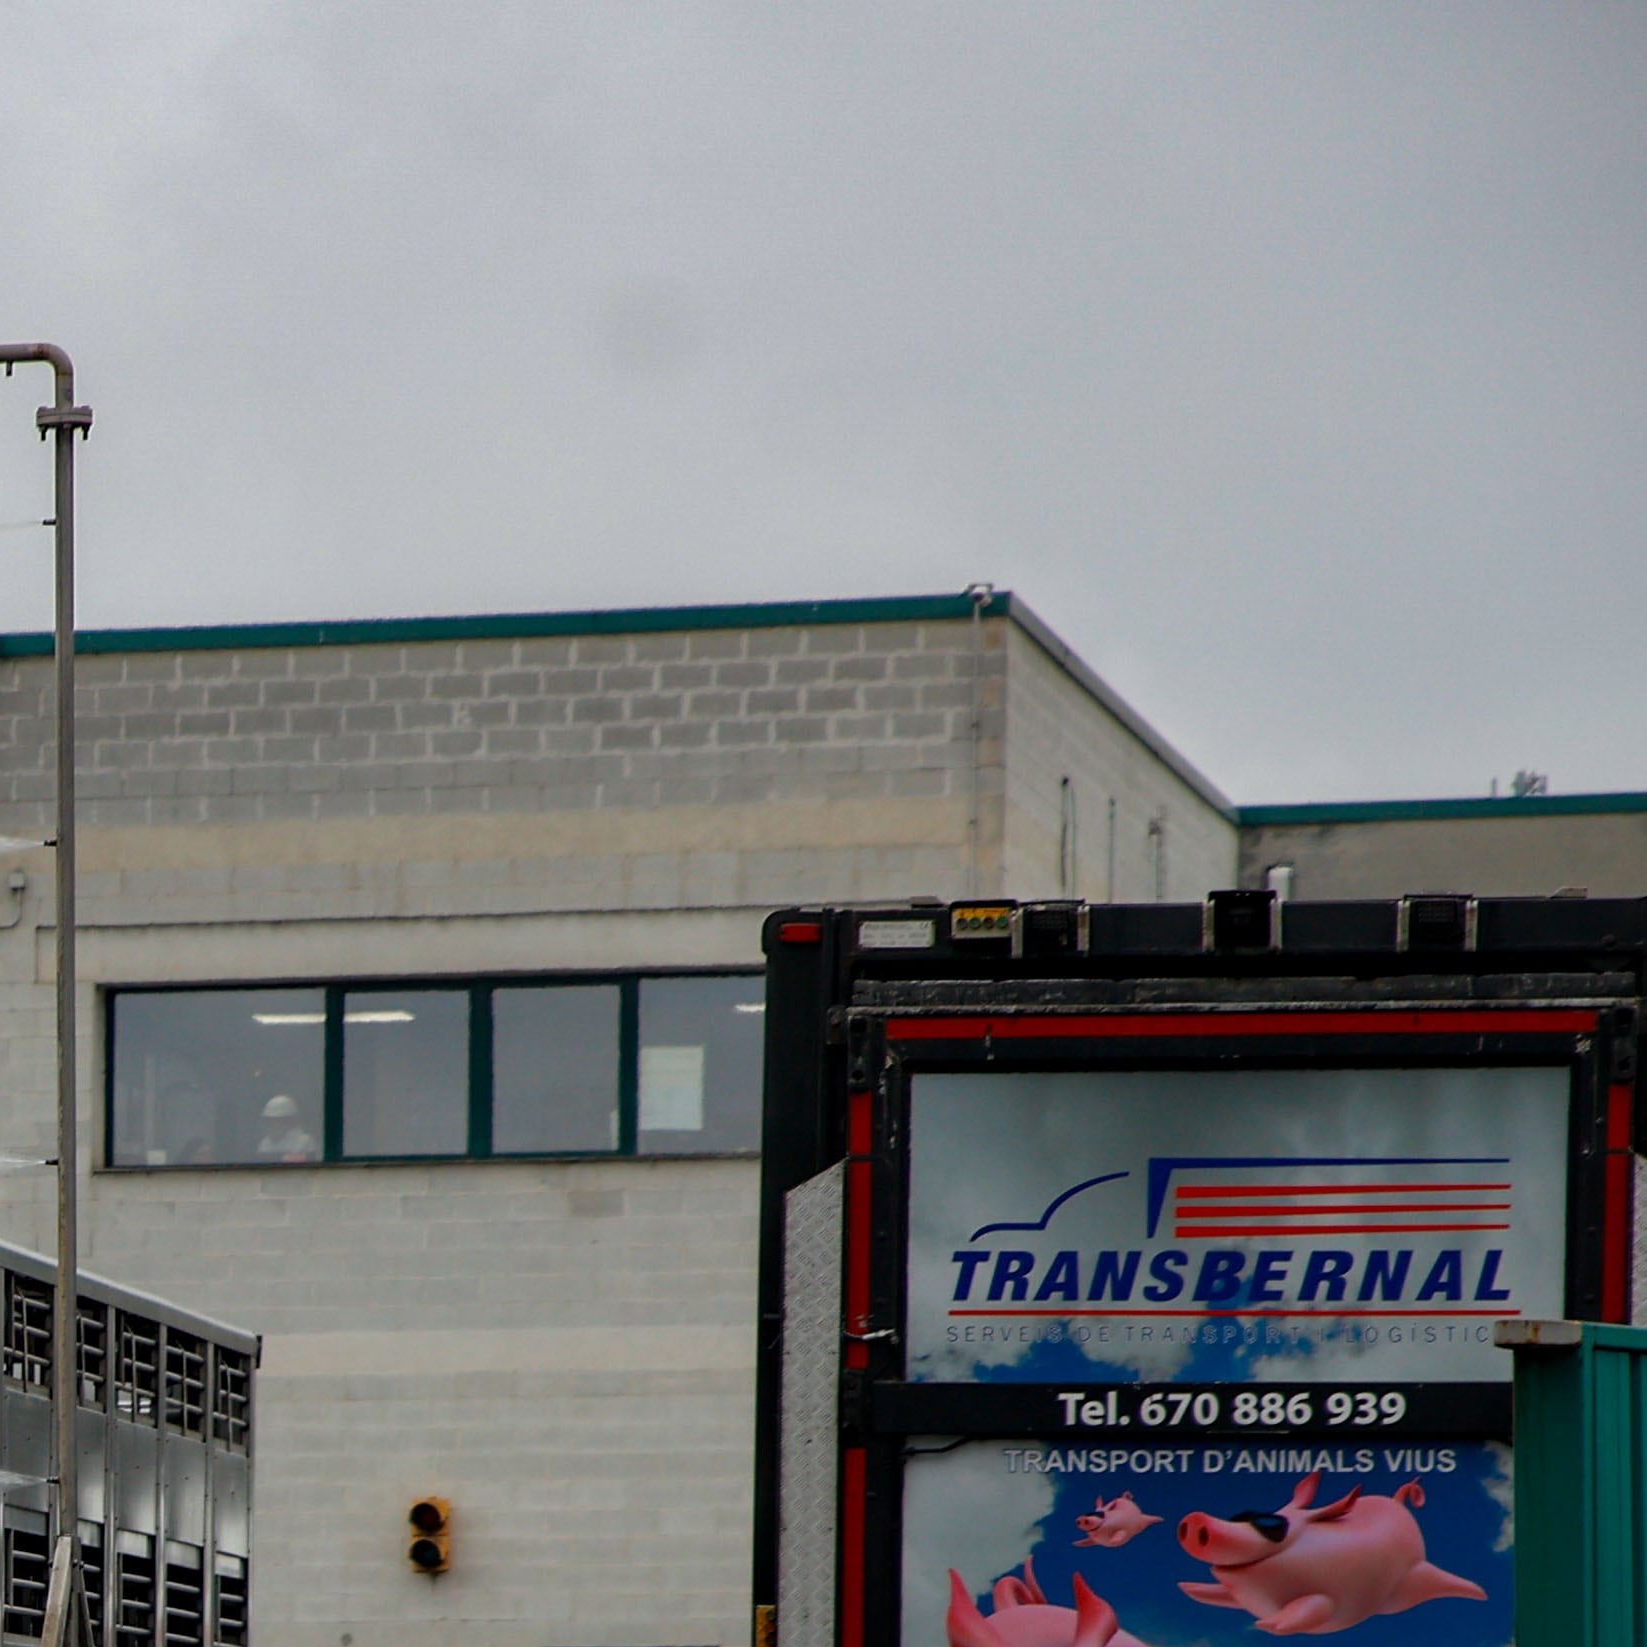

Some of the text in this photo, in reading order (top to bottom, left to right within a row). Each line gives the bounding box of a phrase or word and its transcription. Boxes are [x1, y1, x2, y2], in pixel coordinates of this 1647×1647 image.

[952, 1250, 1511, 1302] TRANSBERNAL
[946, 1326, 1064, 1343] SERVEIS
[1077, 1326, 1110, 1343] DE
[1125, 1326, 1301, 1344] TRANSPORT
[1058, 1391, 1407, 1426] Tel. 670 886 939
[1004, 1449, 1457, 1473] TRANSPORT D'ANIMALS VIUS
